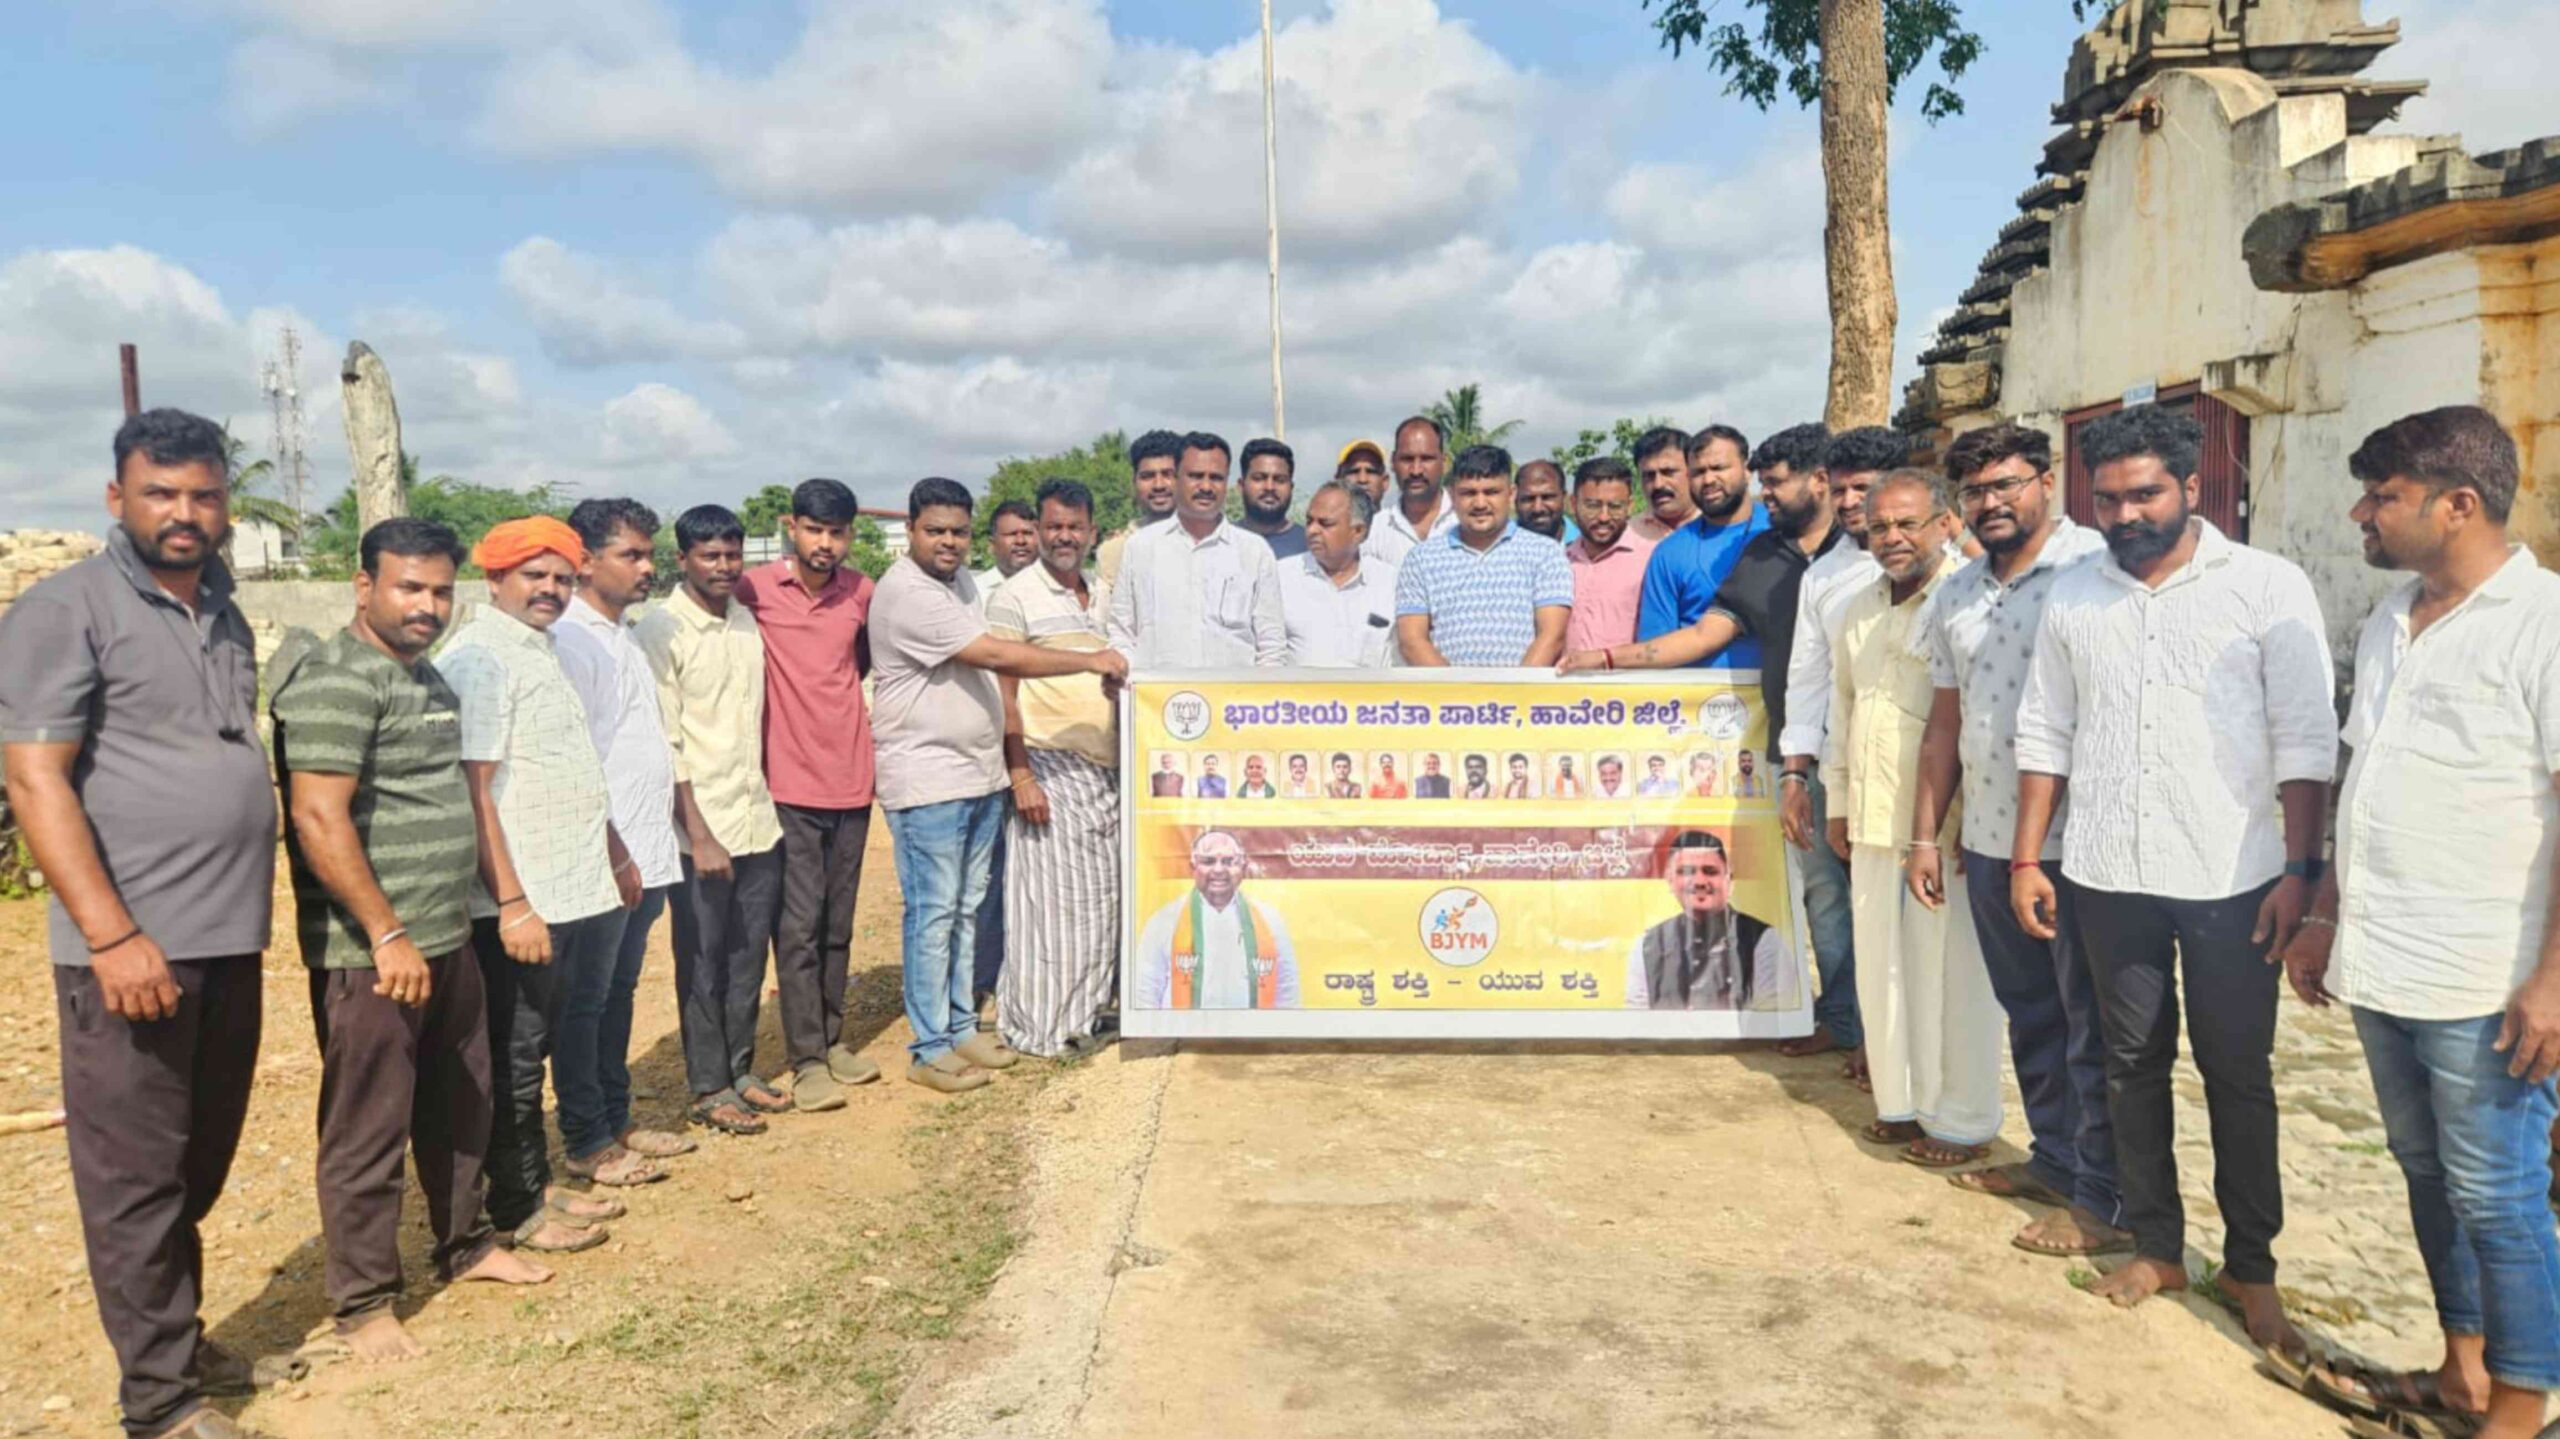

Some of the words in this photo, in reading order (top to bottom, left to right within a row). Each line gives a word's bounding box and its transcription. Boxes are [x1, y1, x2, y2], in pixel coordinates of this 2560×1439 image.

[1224, 700, 1348, 731] ಭಾರತೀಯ
[1356, 701, 1432, 725] ಜನತಾ
[1439, 703, 1522, 727] ಪಾರ್ಟಿ,
[1530, 699, 1625, 725] ಹಾವೇರಿ
[1430, 932, 1488, 950] BJYM
[1324, 970, 1377, 1006] ರಾಷ್ಟ್ರ
[1392, 971, 1429, 998] ಶಕ್ತಿ
[1479, 971, 1543, 990] ಯುವ
[1561, 971, 1598, 998] ಶಕ್ತಿ
